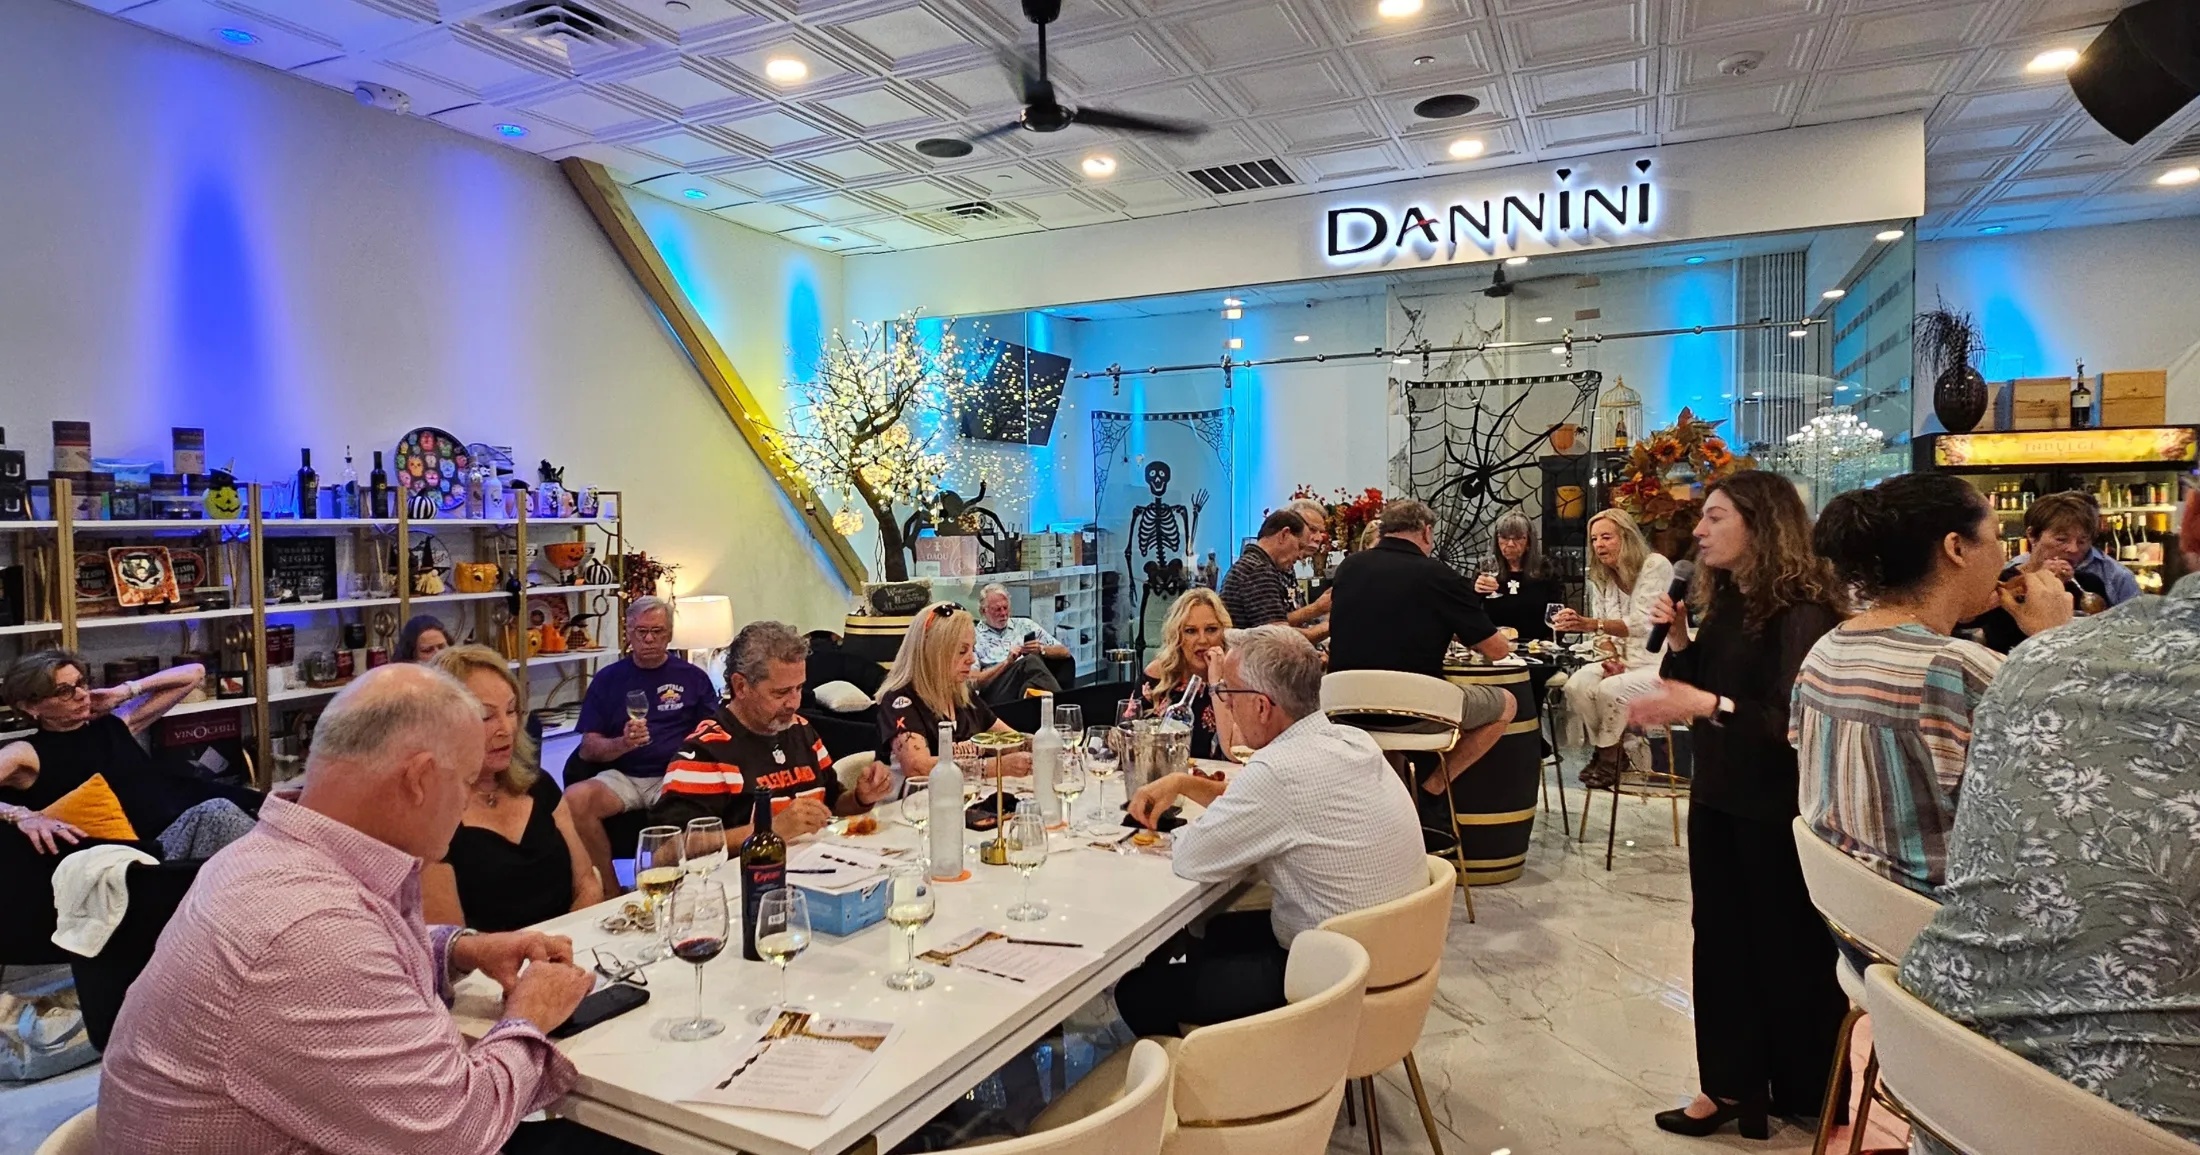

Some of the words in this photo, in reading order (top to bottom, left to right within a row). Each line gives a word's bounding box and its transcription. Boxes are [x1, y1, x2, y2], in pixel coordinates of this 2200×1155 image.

[279, 555, 325, 564] NIGHTS
[926, 552, 949, 561] DAOU
[756, 766, 816, 790] CLEVELAND
